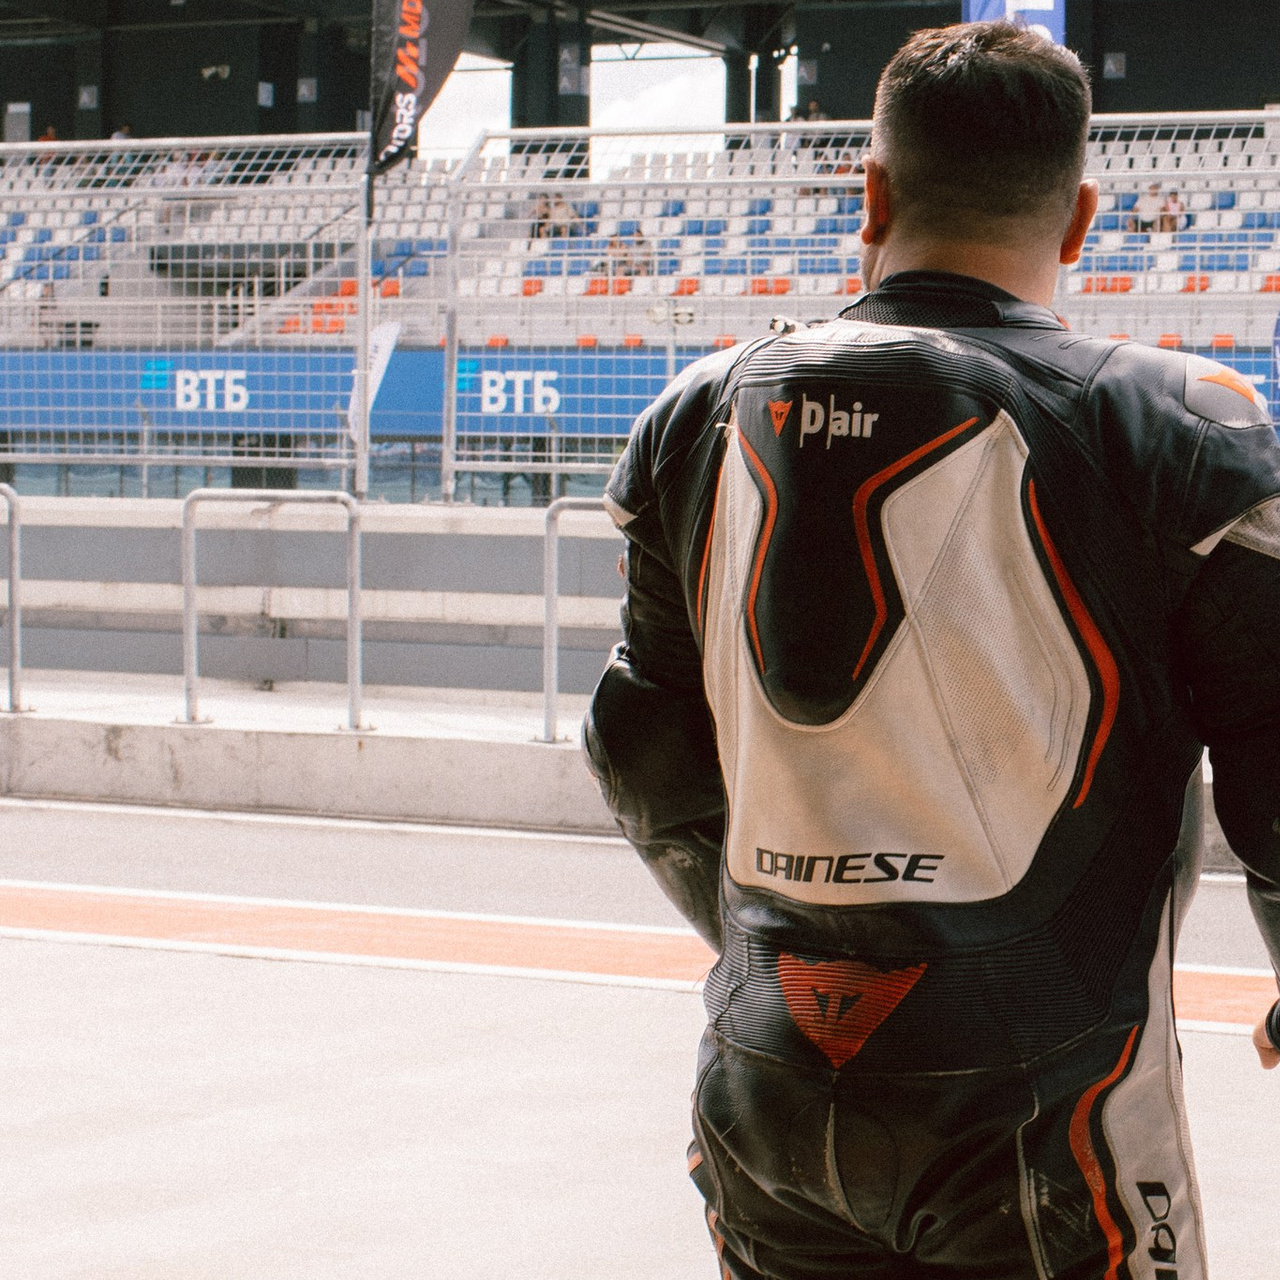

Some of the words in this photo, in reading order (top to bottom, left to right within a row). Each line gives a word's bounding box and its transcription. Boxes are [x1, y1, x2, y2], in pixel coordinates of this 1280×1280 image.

[175, 370, 250, 412] ВТБ
[481, 370, 561, 414] ВТБ
[756, 847, 945, 884] DAINESE
